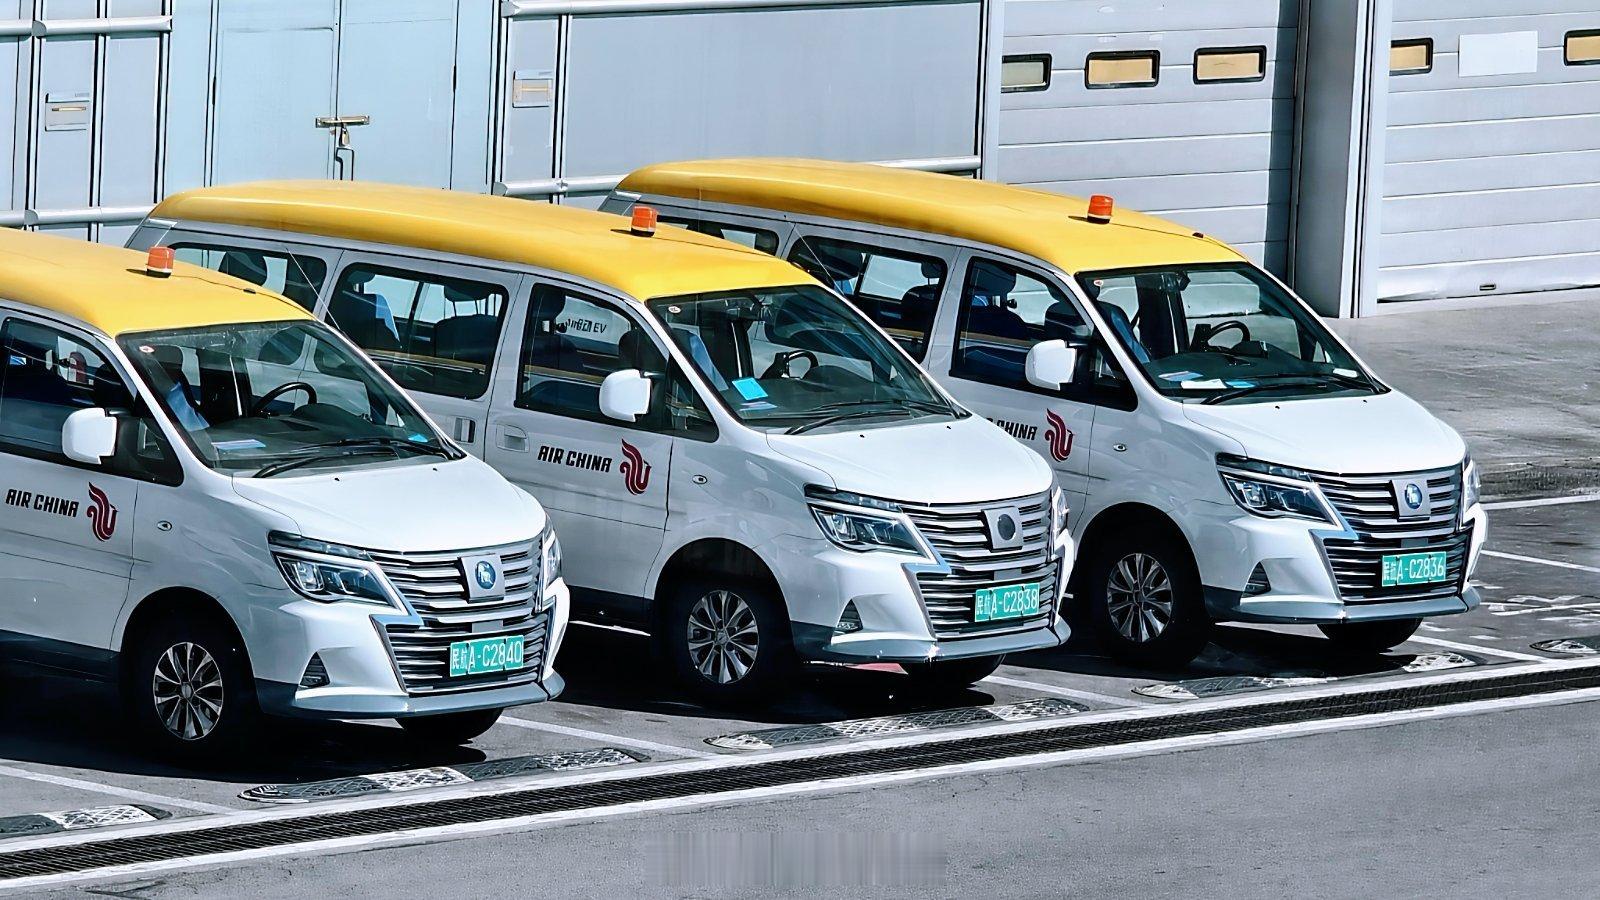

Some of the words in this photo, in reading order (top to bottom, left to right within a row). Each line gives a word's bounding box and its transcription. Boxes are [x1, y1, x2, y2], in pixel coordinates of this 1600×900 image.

[538, 445, 564, 464] AIR
[566, 450, 612, 473] CHINA
[5, 489, 32, 508] AIR
[33, 494, 79, 517] CHINA
